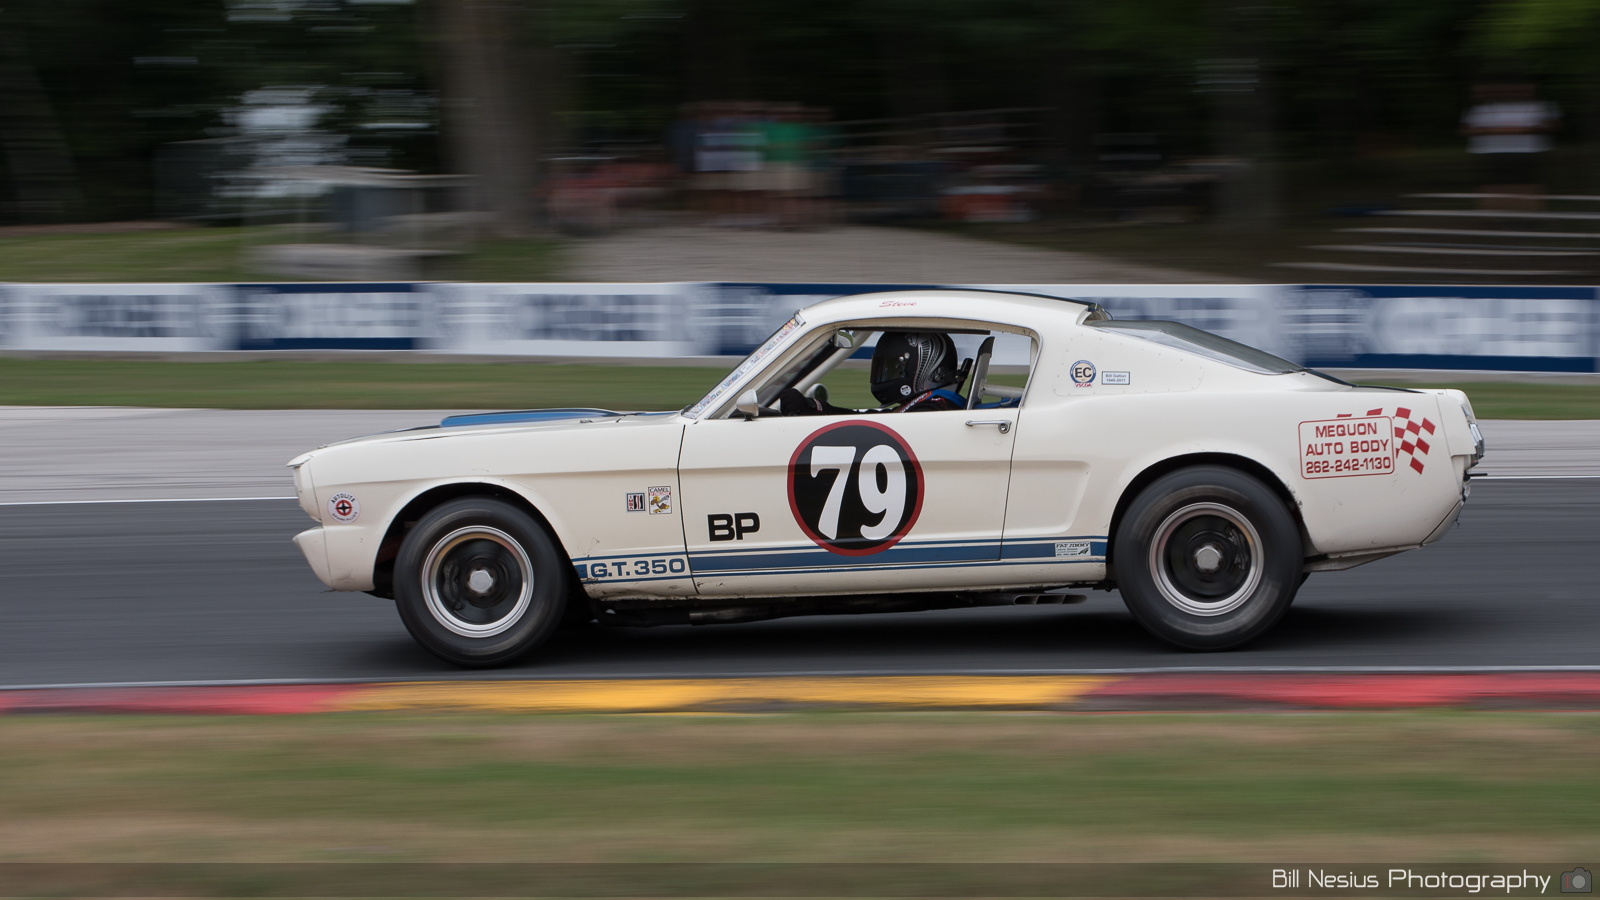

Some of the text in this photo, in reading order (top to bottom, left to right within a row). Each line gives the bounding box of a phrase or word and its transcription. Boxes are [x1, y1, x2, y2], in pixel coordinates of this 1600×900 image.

[879, 300, 918, 308] Steve
[1074, 367, 1093, 378] EC
[1315, 422, 1377, 438] MEQUON
[1305, 438, 1389, 456] AUTO BODY
[1305, 456, 1391, 474] 262-242-1130
[331, 493, 356, 504] AUTOLITE
[810, 444, 907, 541] 79
[707, 512, 760, 542] BP
[590, 558, 686, 578] G.T. 350
